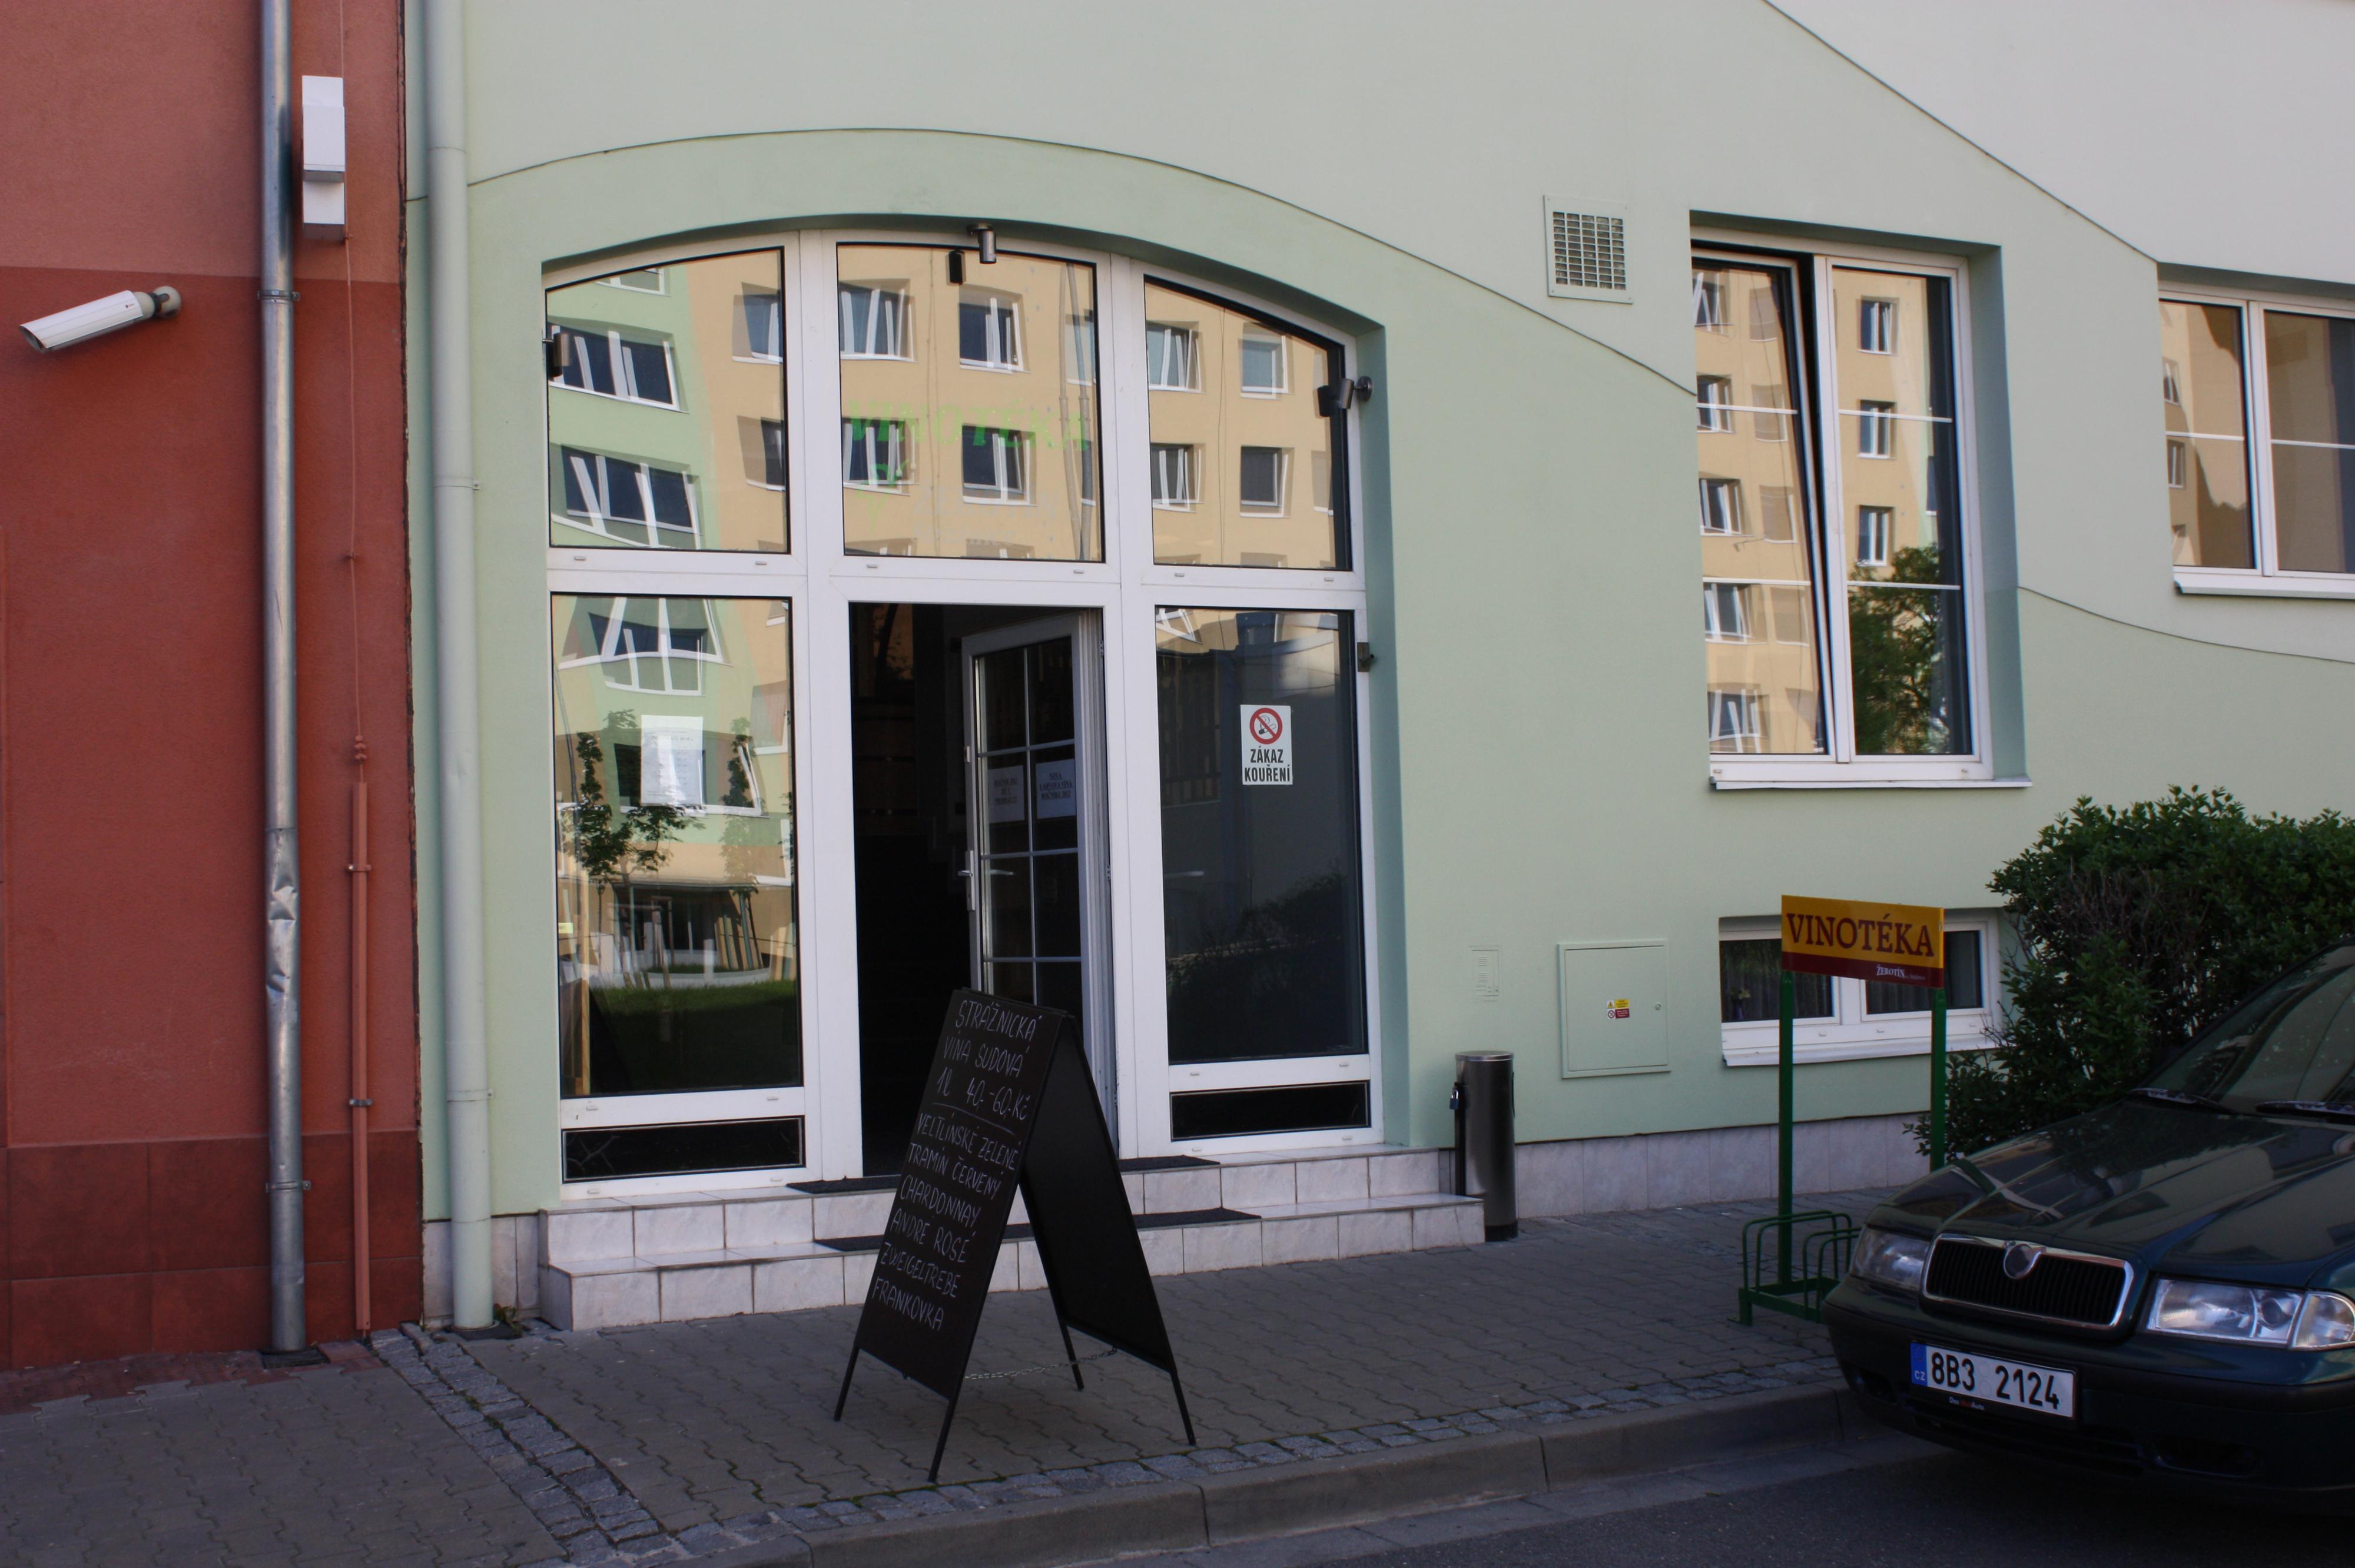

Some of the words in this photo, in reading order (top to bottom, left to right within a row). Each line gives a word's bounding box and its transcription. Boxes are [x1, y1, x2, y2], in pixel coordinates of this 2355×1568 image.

[1245, 764, 1290, 782] KOUŘENÍ
[1251, 746, 1283, 763] ZÁKAZ
[1787, 913, 1934, 957] VINOTÉKA
[1876, 964, 1905, 978] ŽEROTÍN
[956, 1000, 1043, 1041] STRÁŽNICKÁ
[975, 1044, 1030, 1077] SUDOVÁ
[908, 1143, 950, 1175] TRAMÍN
[952, 1155, 1003, 1200] ČERVENÝ
[978, 1137, 1022, 1171] ZELENÉ
[900, 1174, 981, 1227] CHARDONNAY
[934, 1227, 976, 1263] ROSÉ
[881, 1242, 961, 1298] ZWEIGELTREBE
[872, 1276, 944, 1331] FRANKOVKA
[1914, 1370, 1925, 1381] CZ
[1932, 1352, 1975, 1391] 8B3
[1995, 1365, 2059, 1410] 2124
